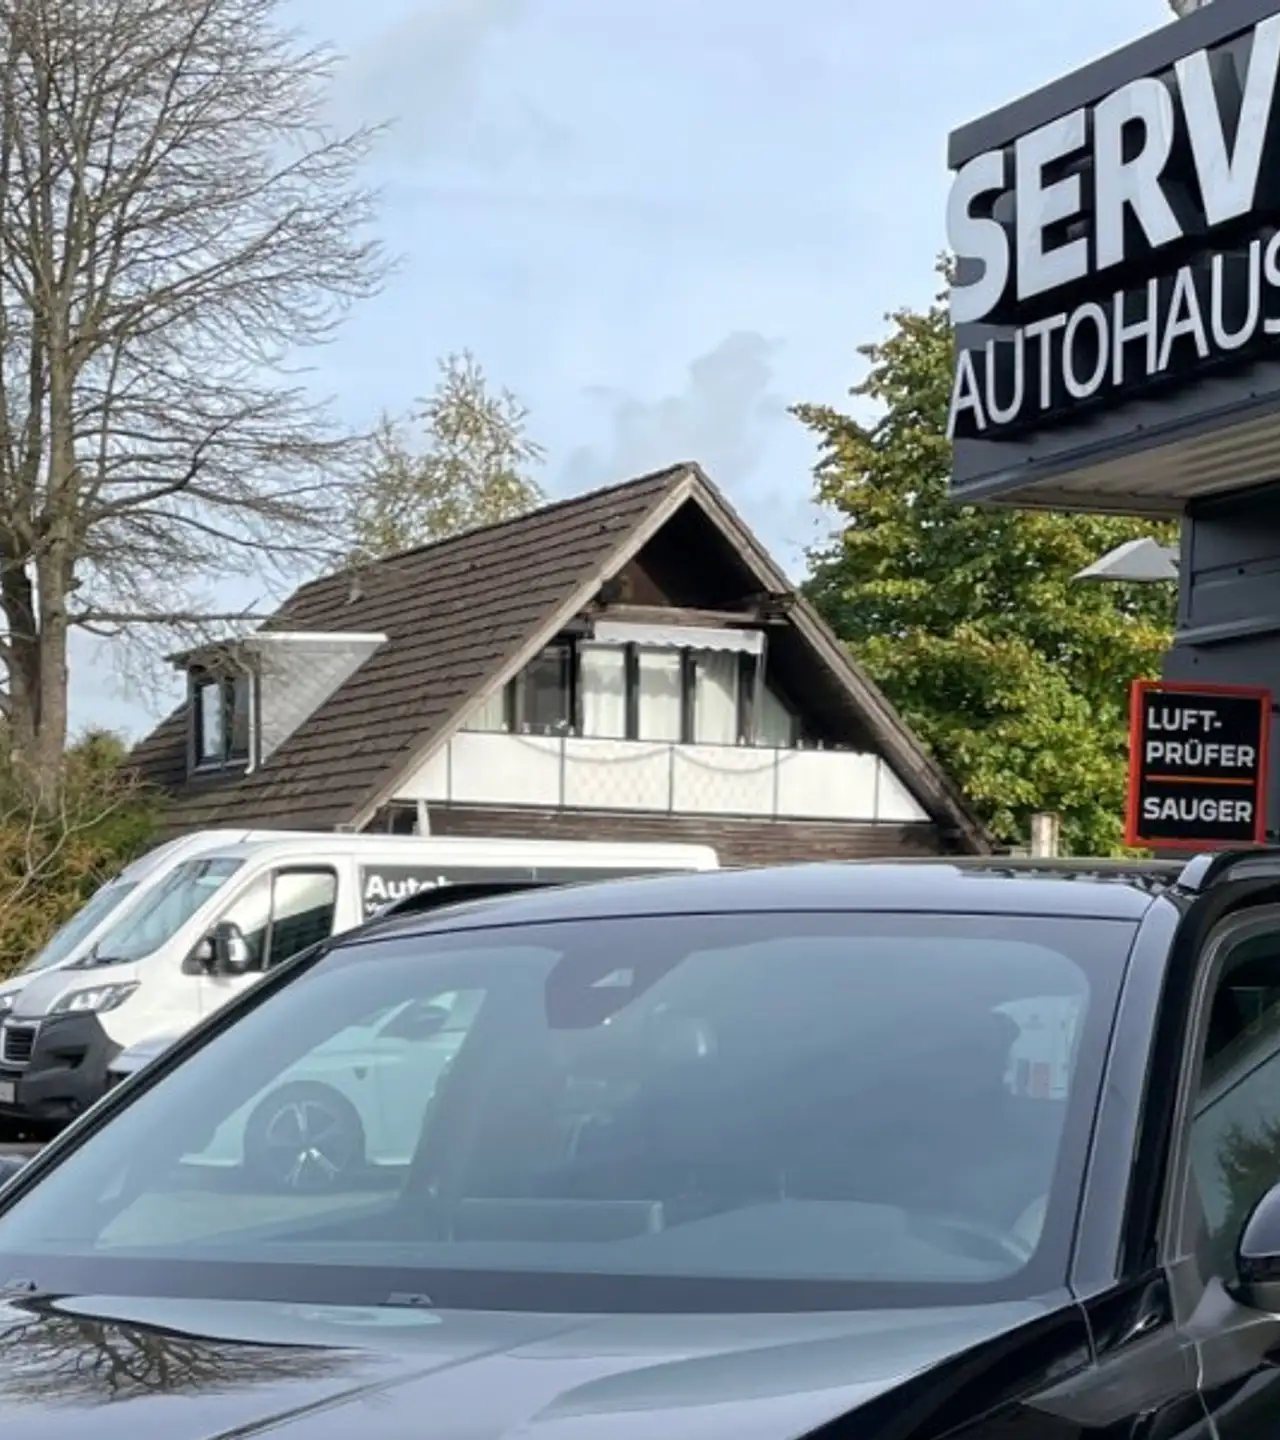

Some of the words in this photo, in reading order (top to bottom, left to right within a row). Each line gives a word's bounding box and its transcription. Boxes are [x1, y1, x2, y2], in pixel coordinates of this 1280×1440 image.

[1147, 706, 1223, 733] LUFT-
[1145, 739, 1256, 768] PRÜFER
[1143, 796, 1253, 823] SAUGER
